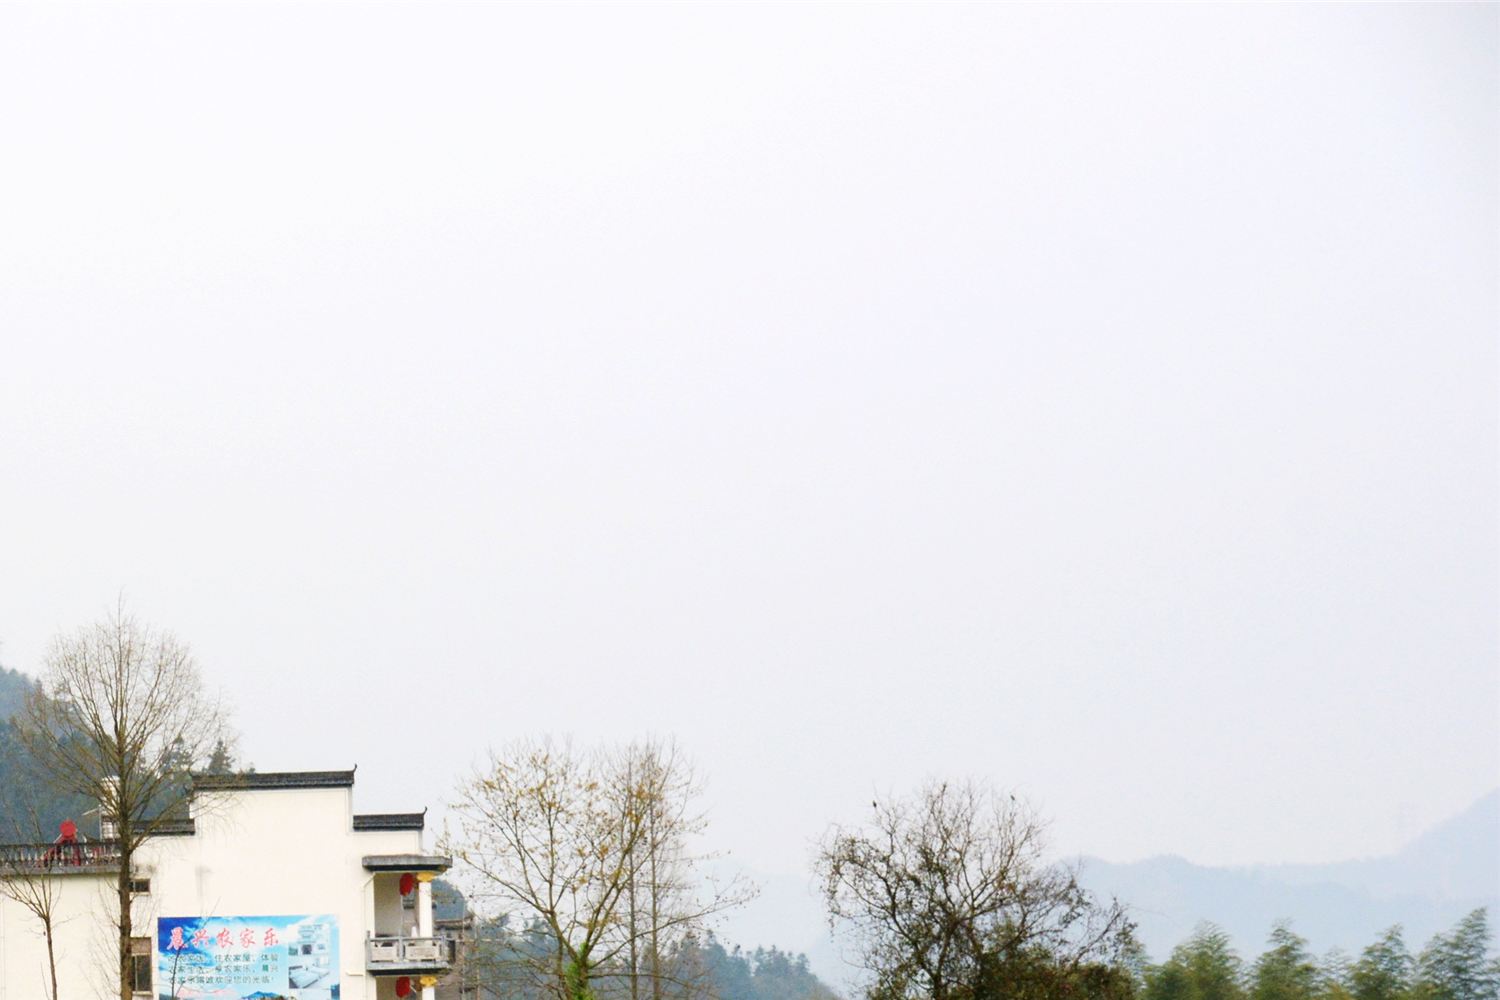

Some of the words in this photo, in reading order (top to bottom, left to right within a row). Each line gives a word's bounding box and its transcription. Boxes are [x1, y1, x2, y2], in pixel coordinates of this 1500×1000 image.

[167, 926, 279, 950] 晨兴农家乐
